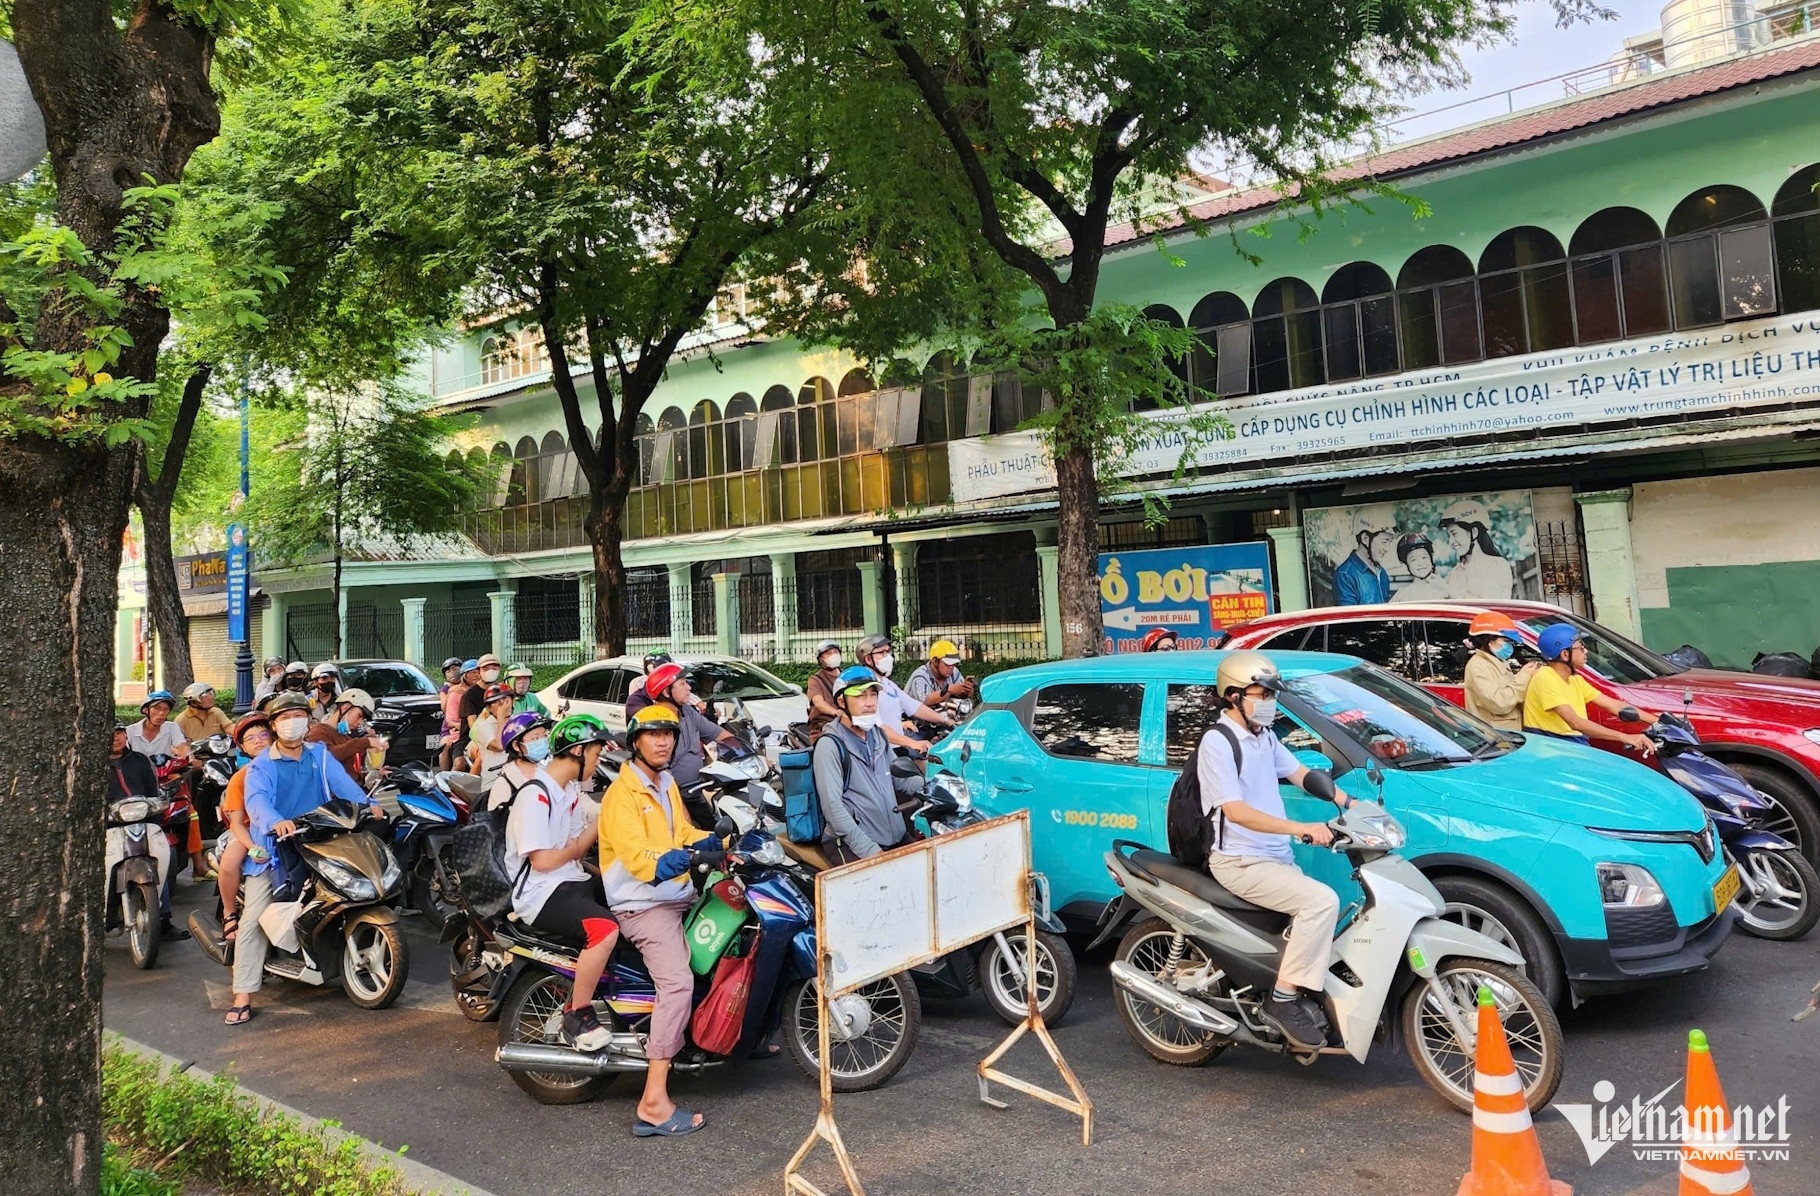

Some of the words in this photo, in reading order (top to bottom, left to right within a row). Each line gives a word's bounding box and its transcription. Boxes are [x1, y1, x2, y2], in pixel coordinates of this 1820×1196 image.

[1274, 412, 1321, 436] DỤNG
[1325, 408, 1347, 429] CỤ
[1351, 398, 1406, 424] CHỈNH
[1411, 393, 1457, 416] HÌNH
[1463, 386, 1500, 410] CÁC
[1505, 382, 1550, 406] LOẠI
[1568, 372, 1606, 400] TẬP
[1612, 366, 1652, 395] VẬT
[1659, 361, 1679, 387] LÝ
[1687, 361, 1724, 384] TRỊ
[1732, 351, 1783, 380] LIỆU
[1369, 430, 1403, 442] Email:
[1242, 596, 1265, 608] TIN
[1064, 808, 1098, 827] 1900
